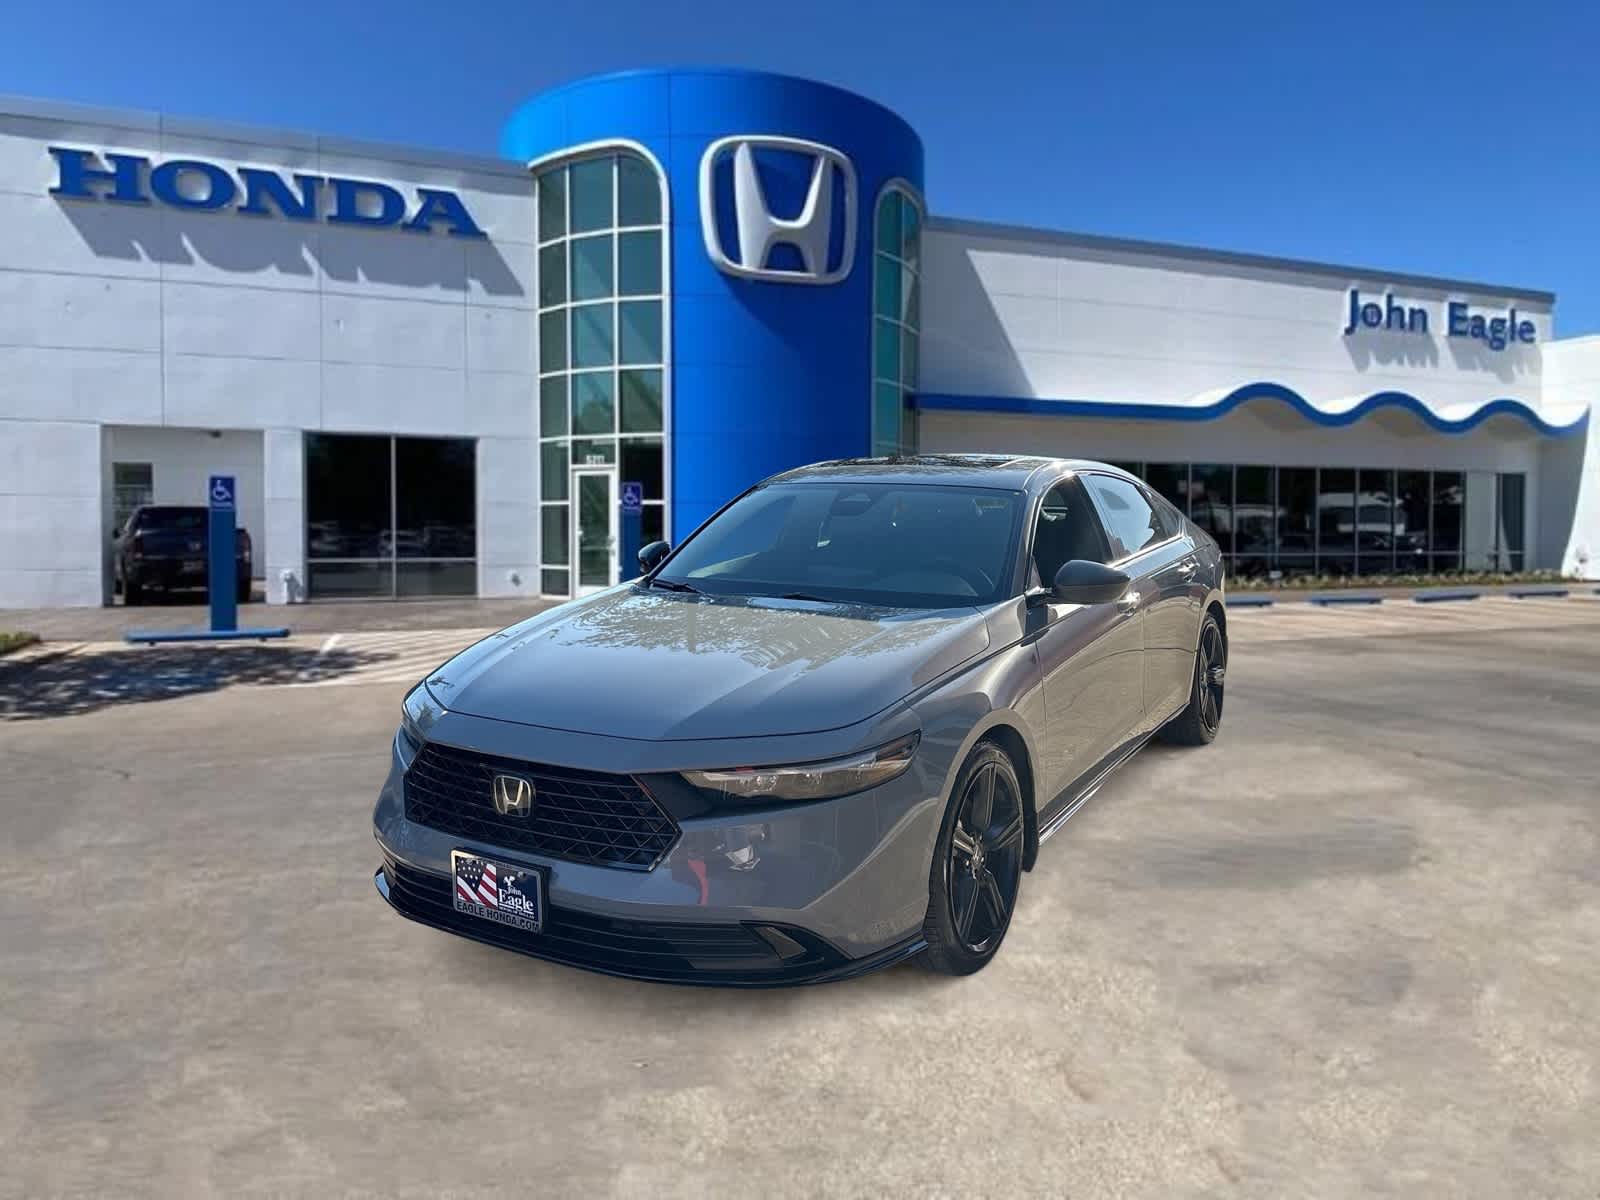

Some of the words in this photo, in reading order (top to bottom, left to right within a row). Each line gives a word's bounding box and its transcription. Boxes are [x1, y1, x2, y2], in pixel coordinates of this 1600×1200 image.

[48, 146, 488, 239] HONDA
[1344, 288, 1430, 337] John
[1447, 301, 1537, 351] Eagle
[498, 888, 534, 912] Eagle
[507, 886, 522, 897] John
[457, 901, 485, 917] EAGLE
